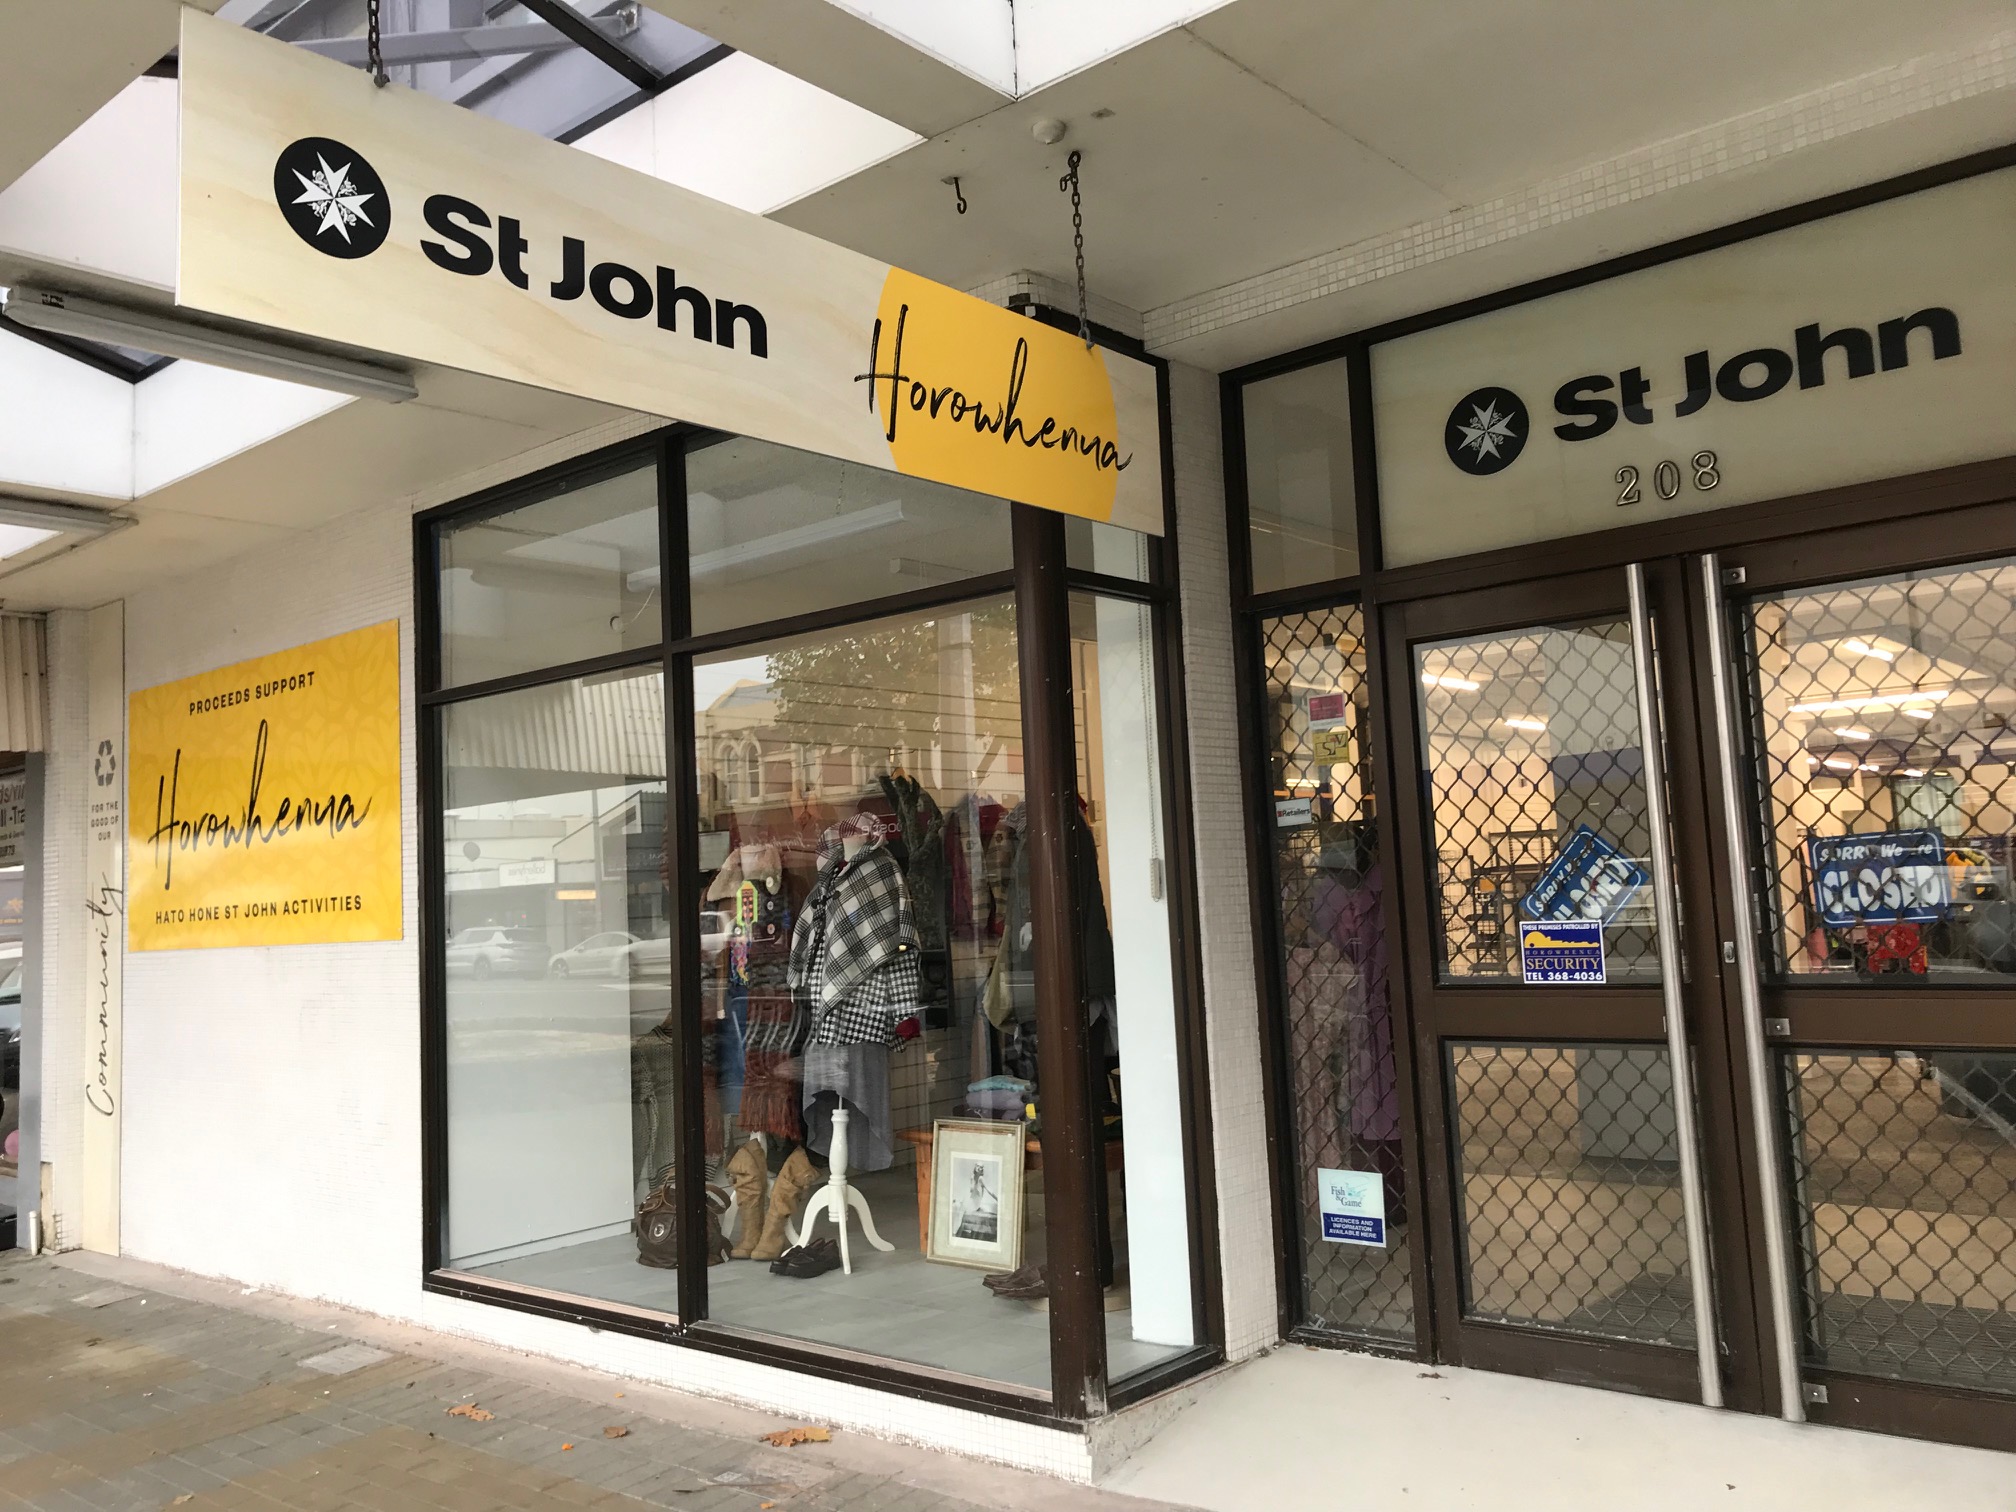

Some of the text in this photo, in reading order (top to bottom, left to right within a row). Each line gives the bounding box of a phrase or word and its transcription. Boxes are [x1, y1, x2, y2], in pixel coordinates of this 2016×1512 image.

[420, 194, 768, 359] St John
[1553, 306, 1962, 441] St John
[854, 304, 1134, 471] Horowhenua
[1615, 450, 1720, 506] 208
[189, 671, 315, 715] PROCEEDS SUPPORT
[91, 801, 118, 813] FOR THE
[148, 719, 372, 890] Horowhenua
[91, 815, 119, 828] GOOD OF
[98, 831, 111, 841] OUR
[1823, 865, 1942, 915] CLOSED
[156, 895, 362, 925] HATO HONE ST JOHN ACTIVITIES
[1526, 958, 1600, 970] SECURITY
[1526, 972, 1603, 981] TEL 368-4036
[86, 871, 123, 1117] Community
[1331, 1186, 1346, 1197] Fish
[1341, 1197, 1362, 1208] Game
[1331, 1217, 1359, 1225] LICENCES
[1333, 1223, 1373, 1232] INFORMATION
[1329, 1229, 1377, 1239] AVAILABLE HERE
